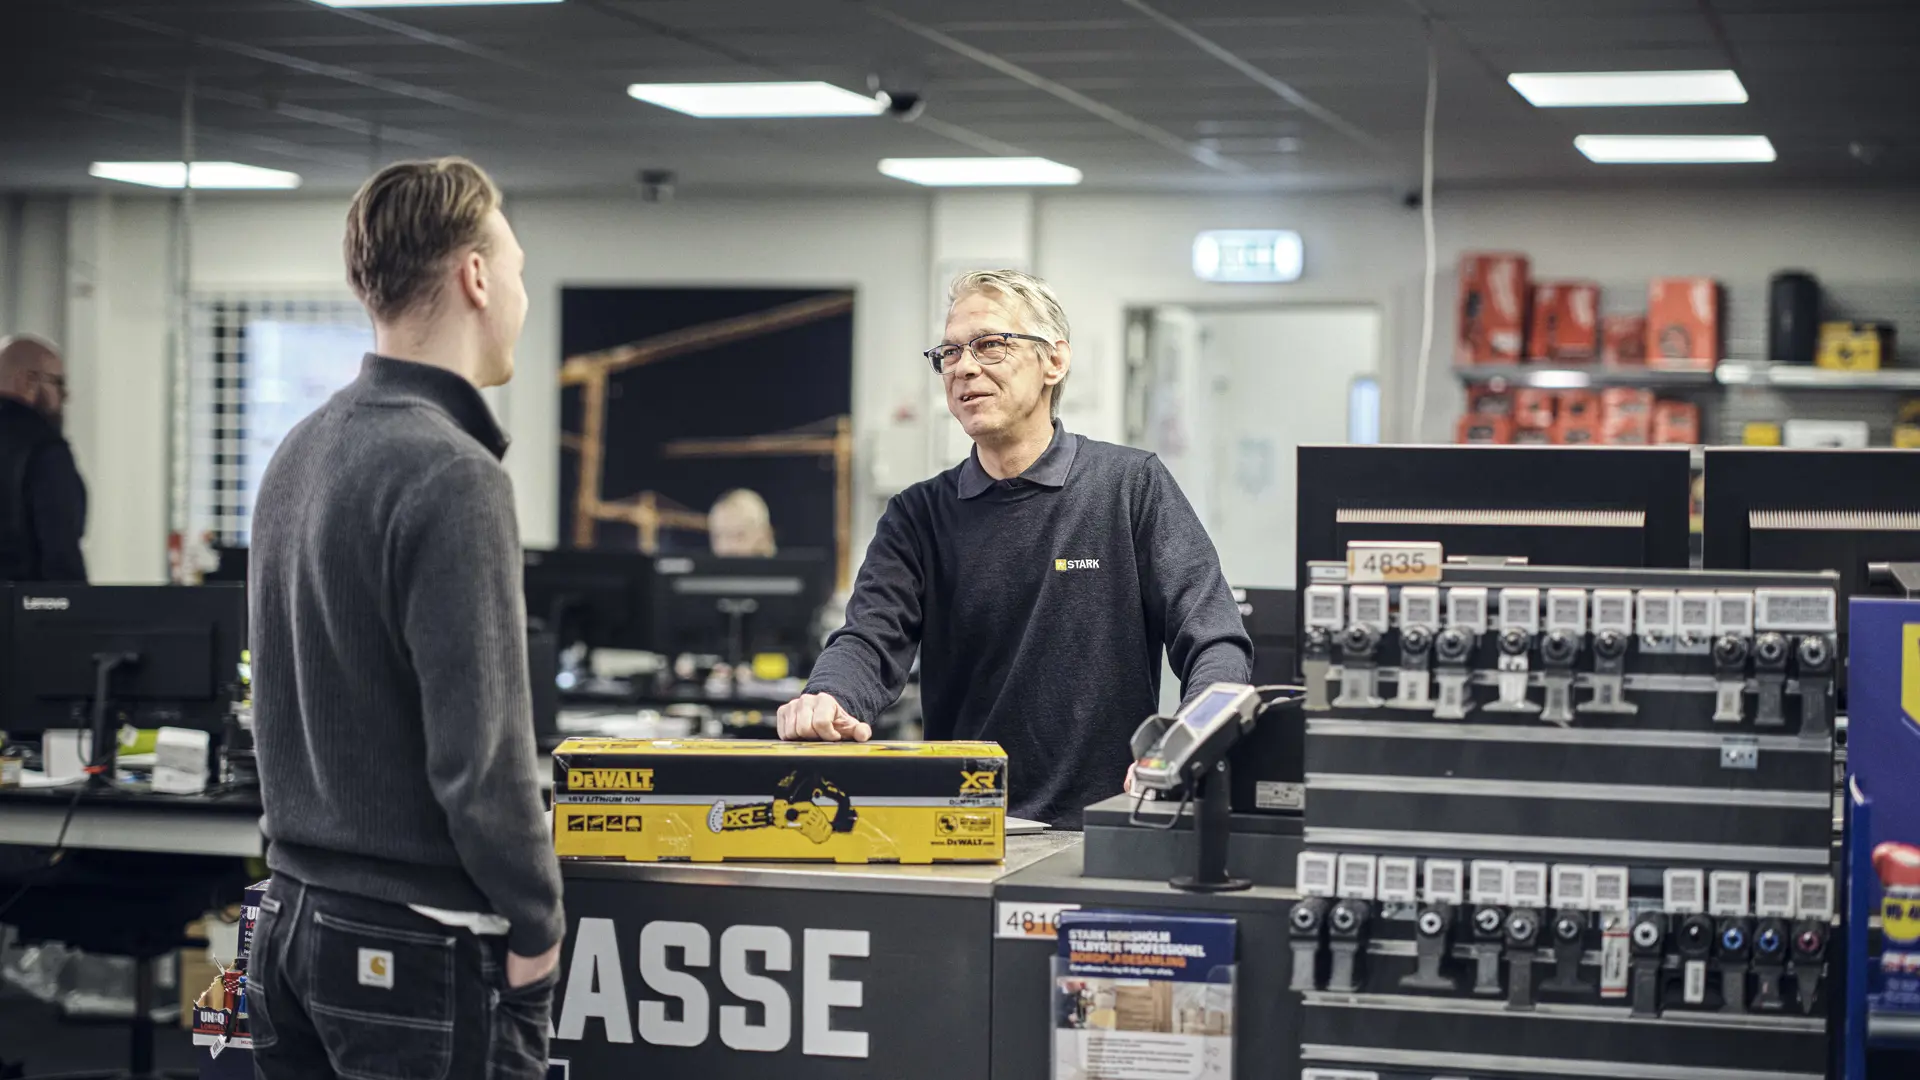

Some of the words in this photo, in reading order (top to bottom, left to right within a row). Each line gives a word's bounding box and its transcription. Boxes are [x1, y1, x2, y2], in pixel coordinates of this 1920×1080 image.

[1067, 559, 1100, 569] STARK
[1363, 552, 1427, 575] 4835
[23, 595, 70, 610] Lenovo
[960, 770, 997, 789] XR
[1068, 929, 1105, 941] STARK
[1069, 940, 1122, 953] TILBYDER
[1123, 943, 1206, 957] PROFESSIONEL
[548, 917, 870, 1058] ASSE
